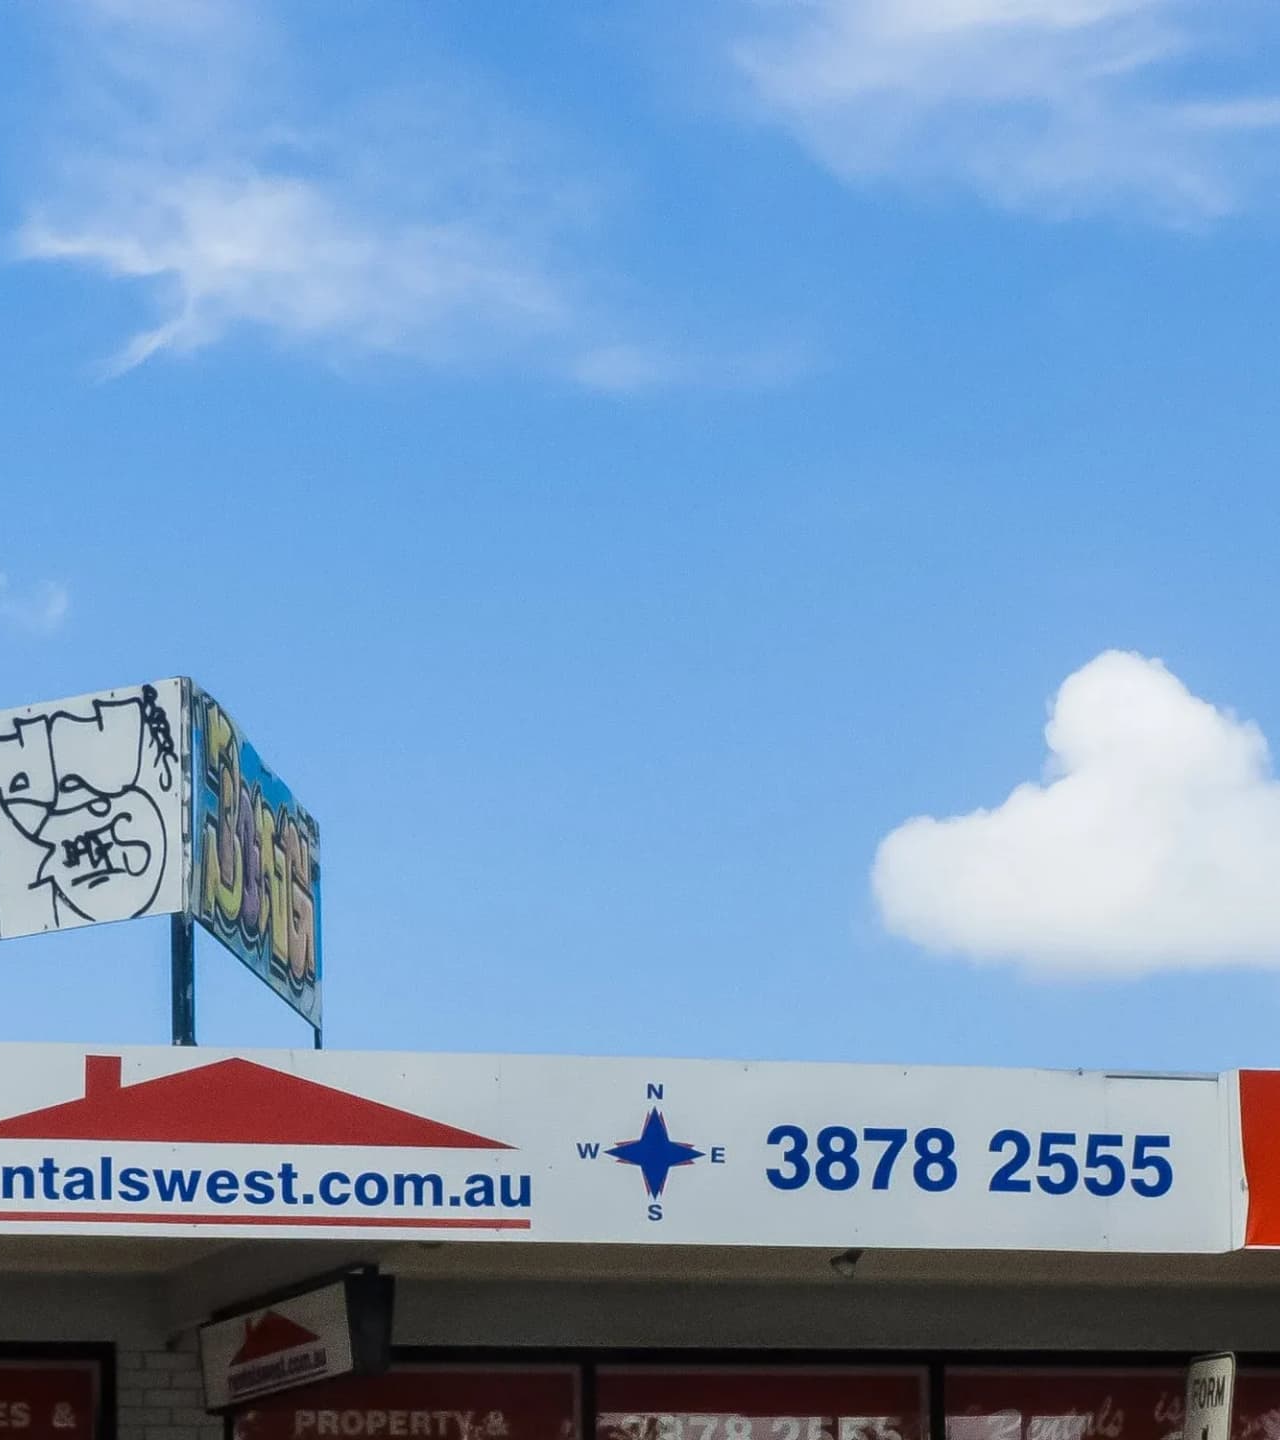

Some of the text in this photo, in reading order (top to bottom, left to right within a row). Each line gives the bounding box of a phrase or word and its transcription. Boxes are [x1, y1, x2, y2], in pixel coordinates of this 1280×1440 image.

[647, 1084, 663, 1100] N
[577, 1143, 600, 1160] W
[711, 1147, 725, 1163] E
[766, 1125, 1173, 1198] 3878 2555
[647, 1205, 663, 1221] S
[1192, 1375, 1225, 1408] FORM
[52, 1402, 76, 1429] &
[294, 1410, 471, 1437] PROPERTY
